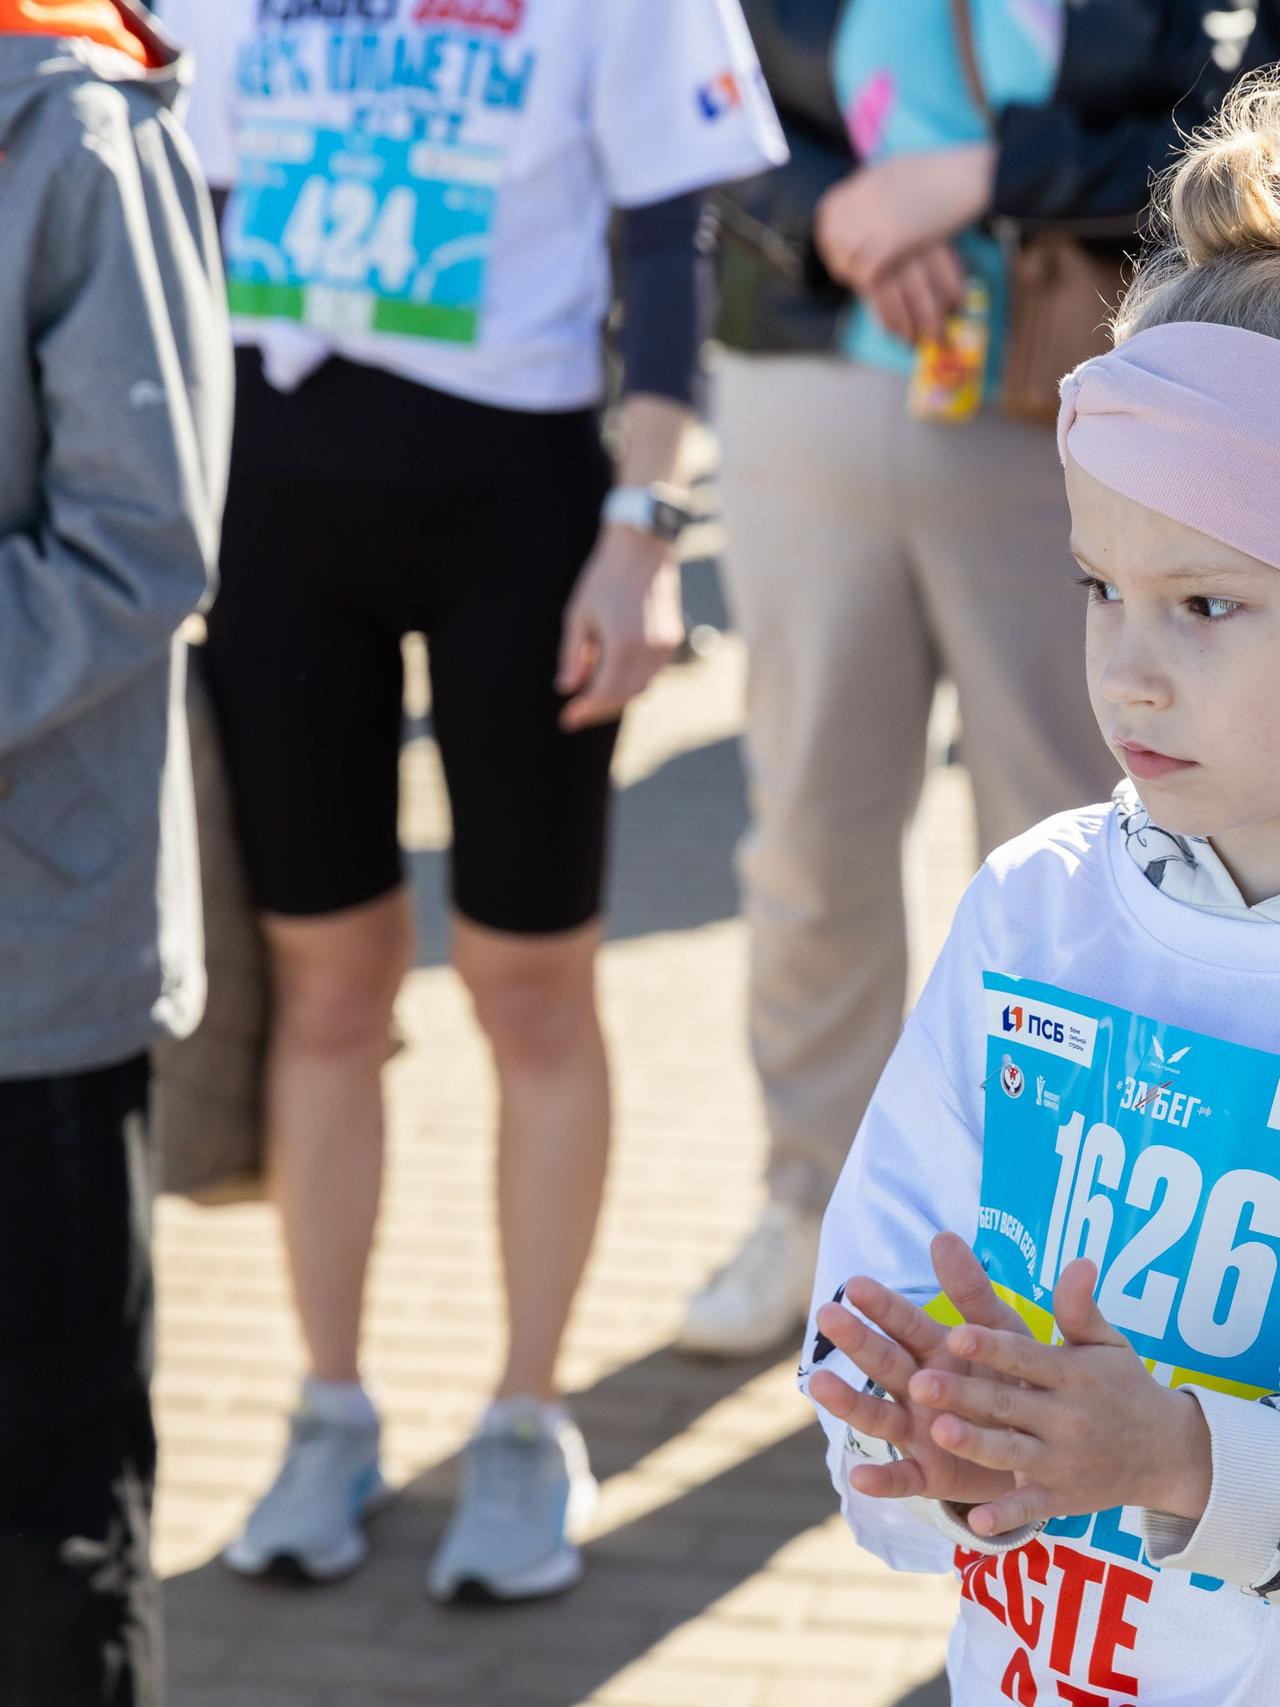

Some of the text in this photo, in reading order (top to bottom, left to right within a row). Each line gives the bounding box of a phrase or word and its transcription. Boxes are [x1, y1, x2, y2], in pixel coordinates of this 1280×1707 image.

[282, 172, 421, 292] 424
[1028, 1014, 1065, 1044] ПСБ
[1000, 1211, 1024, 1246] ВСЕМ
